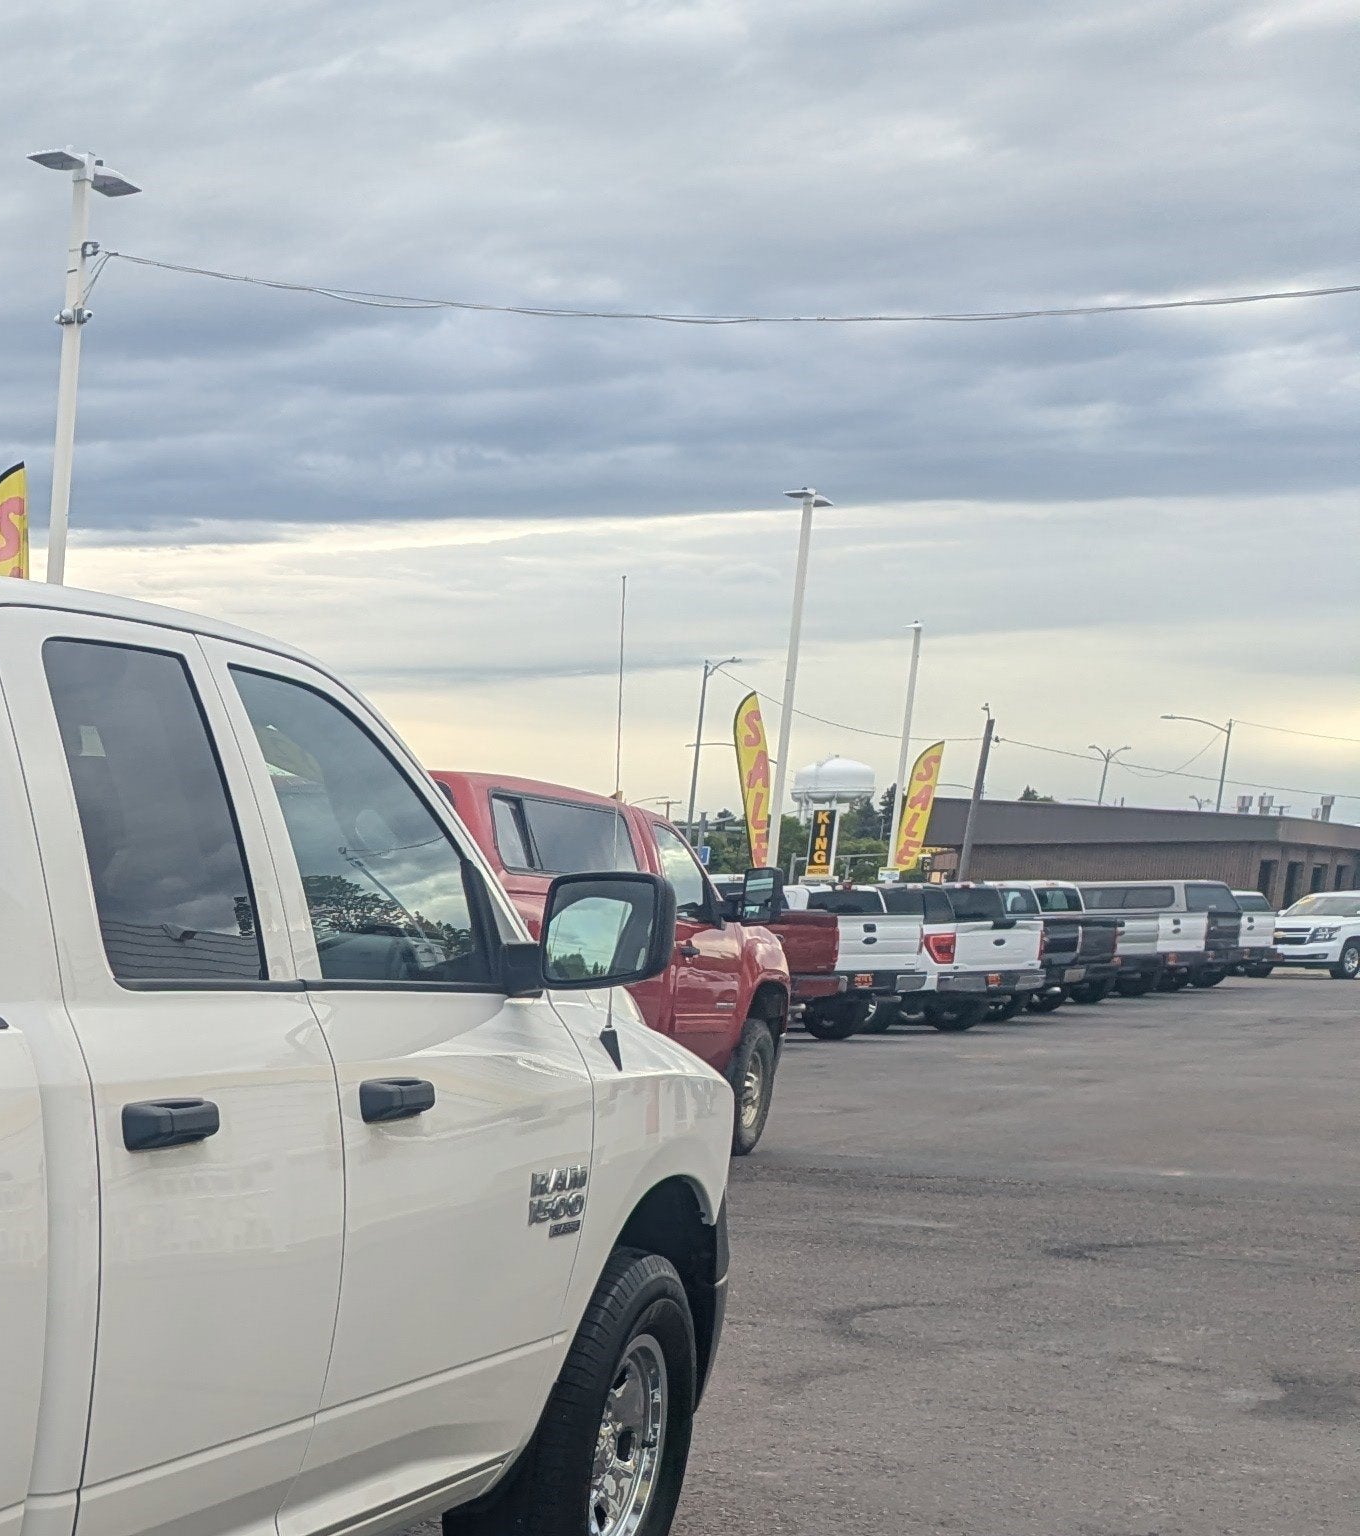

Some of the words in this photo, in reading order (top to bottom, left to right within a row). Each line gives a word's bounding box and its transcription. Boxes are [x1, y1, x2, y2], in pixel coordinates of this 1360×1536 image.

[895, 754, 942, 865] SALE
[813, 811, 831, 864] KING
[530, 1166, 588, 1197] RAM
[528, 1191, 585, 1226] 1500
